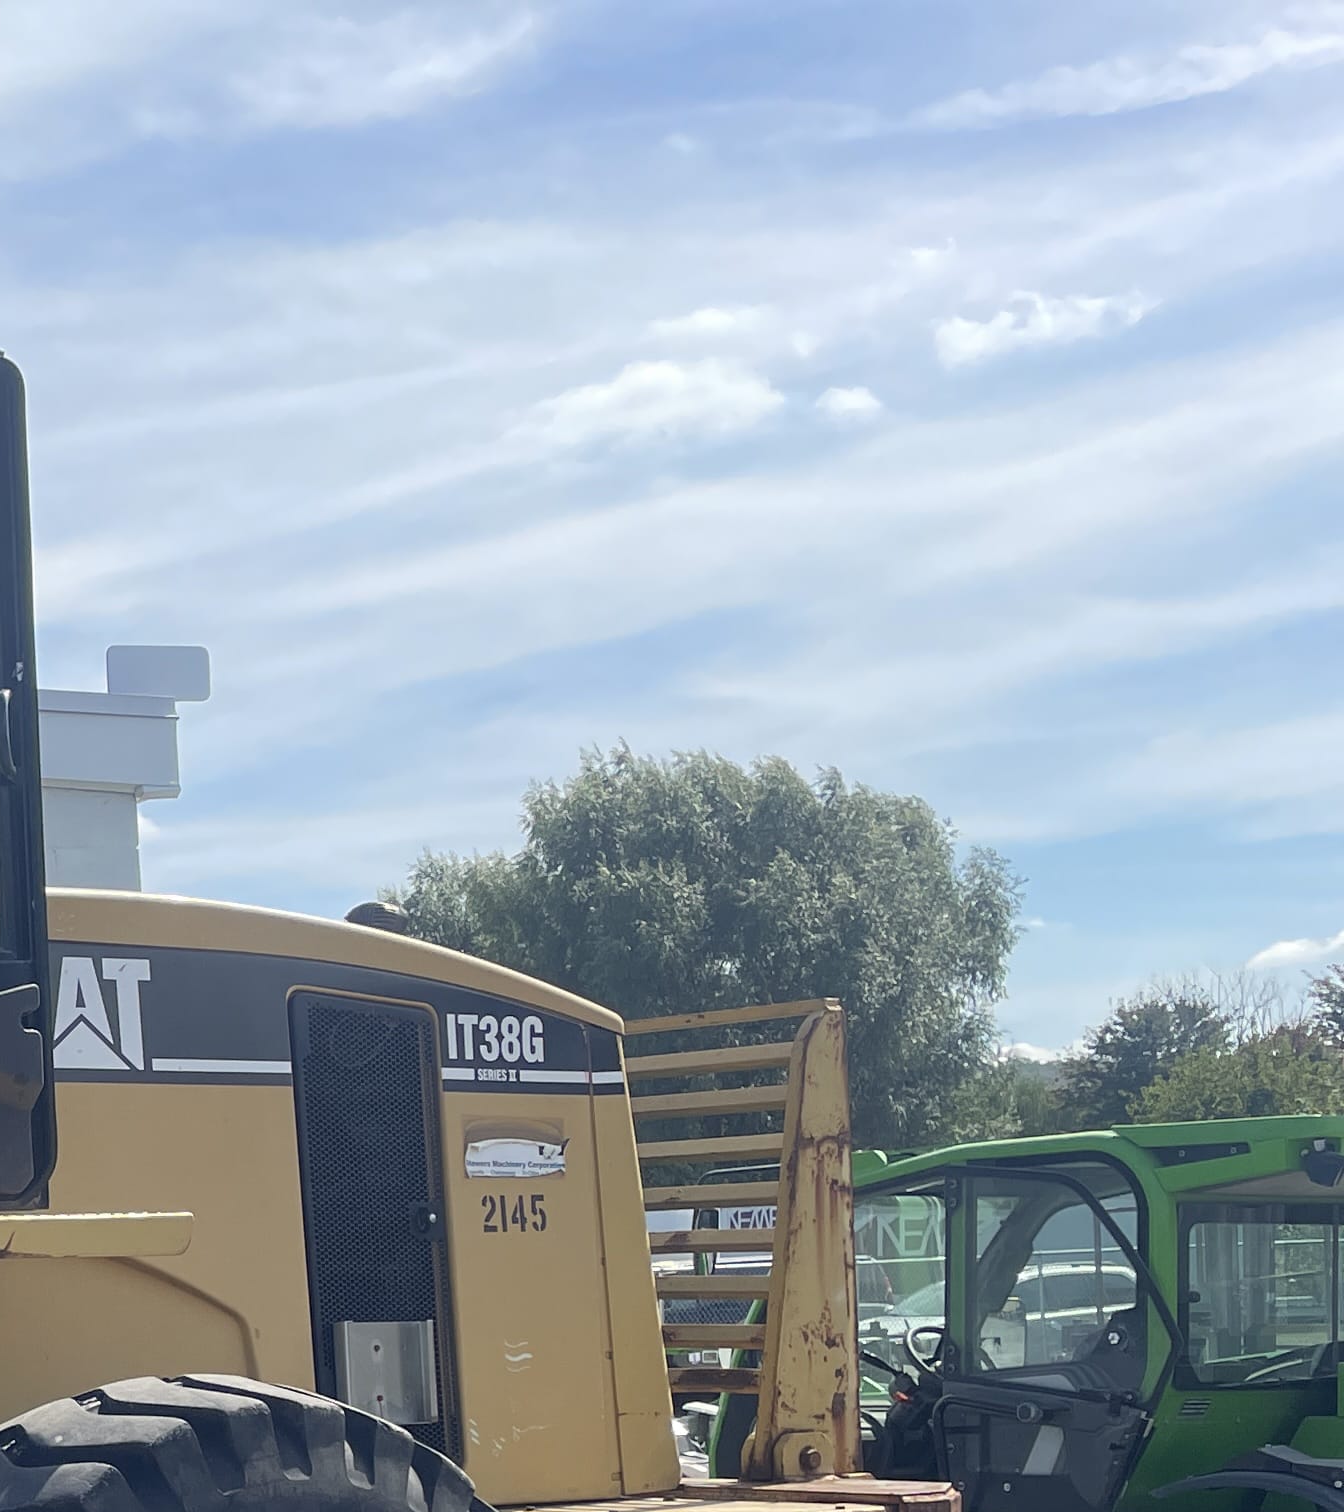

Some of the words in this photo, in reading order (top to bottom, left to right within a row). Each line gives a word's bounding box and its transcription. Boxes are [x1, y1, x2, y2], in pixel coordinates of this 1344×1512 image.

[52, 956, 151, 1071] AT
[446, 1013, 544, 1063] IT38G
[477, 1068, 508, 1082] SERIES
[508, 1069, 518, 1082] II
[481, 1194, 547, 1233] 2145
